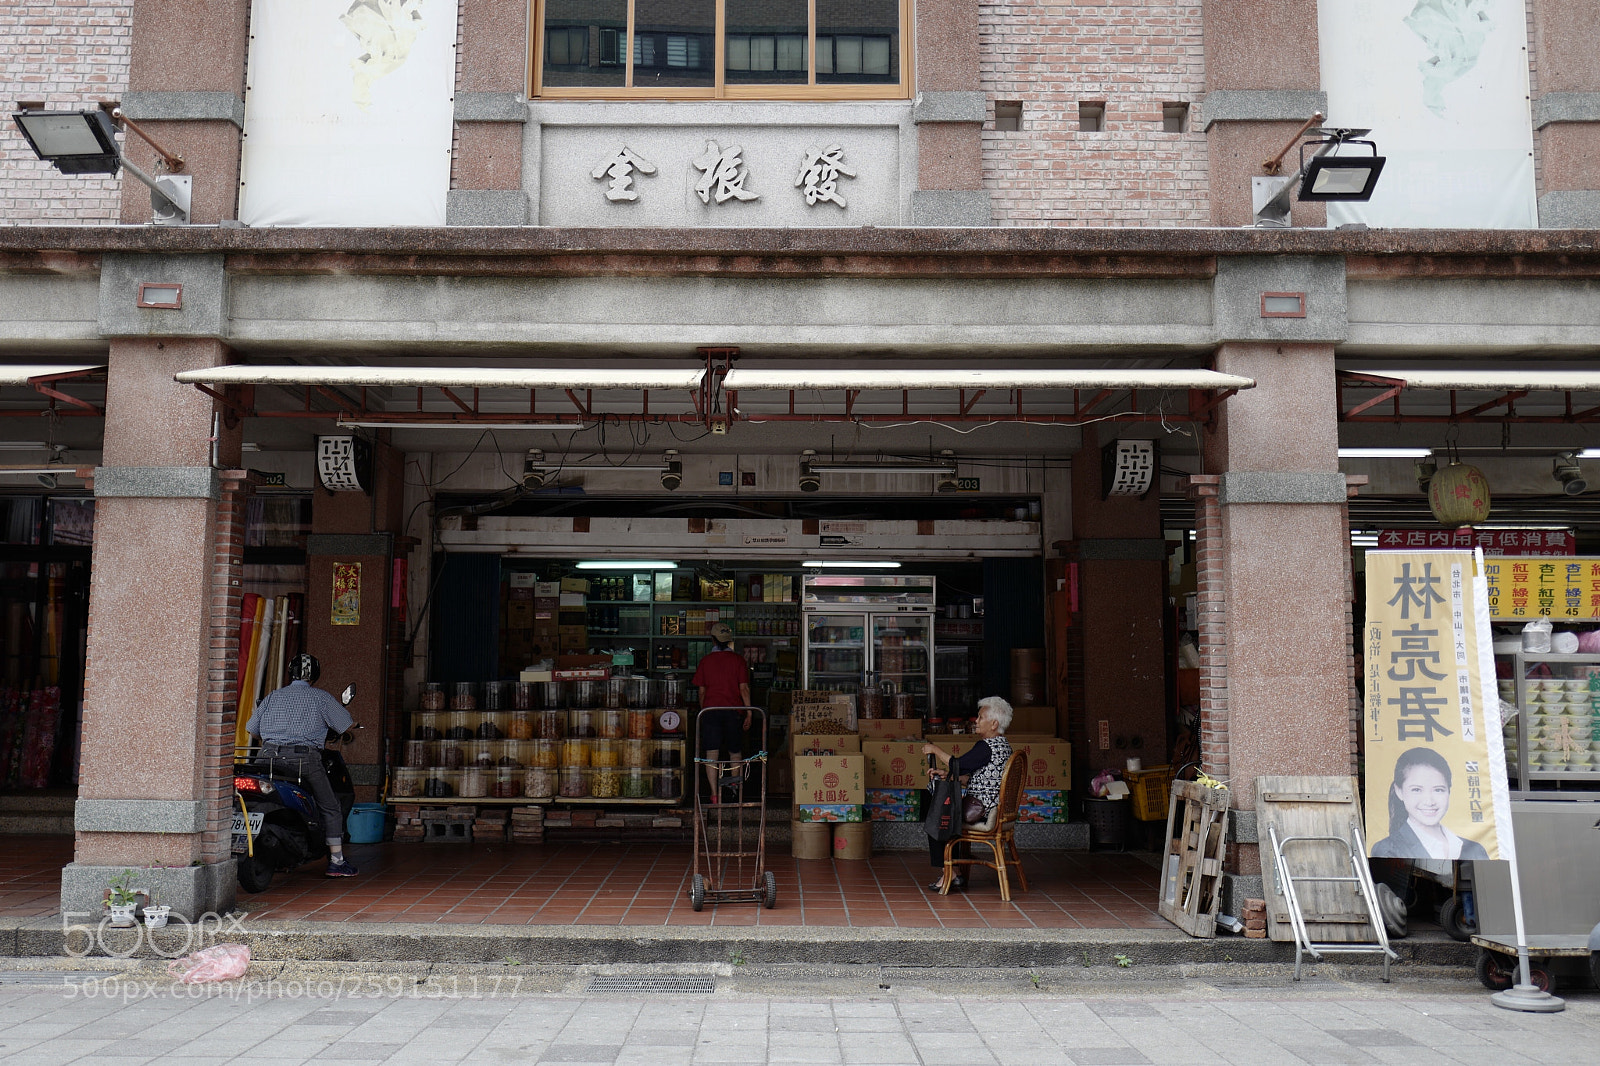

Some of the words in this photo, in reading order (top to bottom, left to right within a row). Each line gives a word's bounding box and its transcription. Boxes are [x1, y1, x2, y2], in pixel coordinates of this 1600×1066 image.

[1512, 608, 1526, 616] 45
[1539, 608, 1552, 616] 45
[1566, 608, 1579, 616] 45
